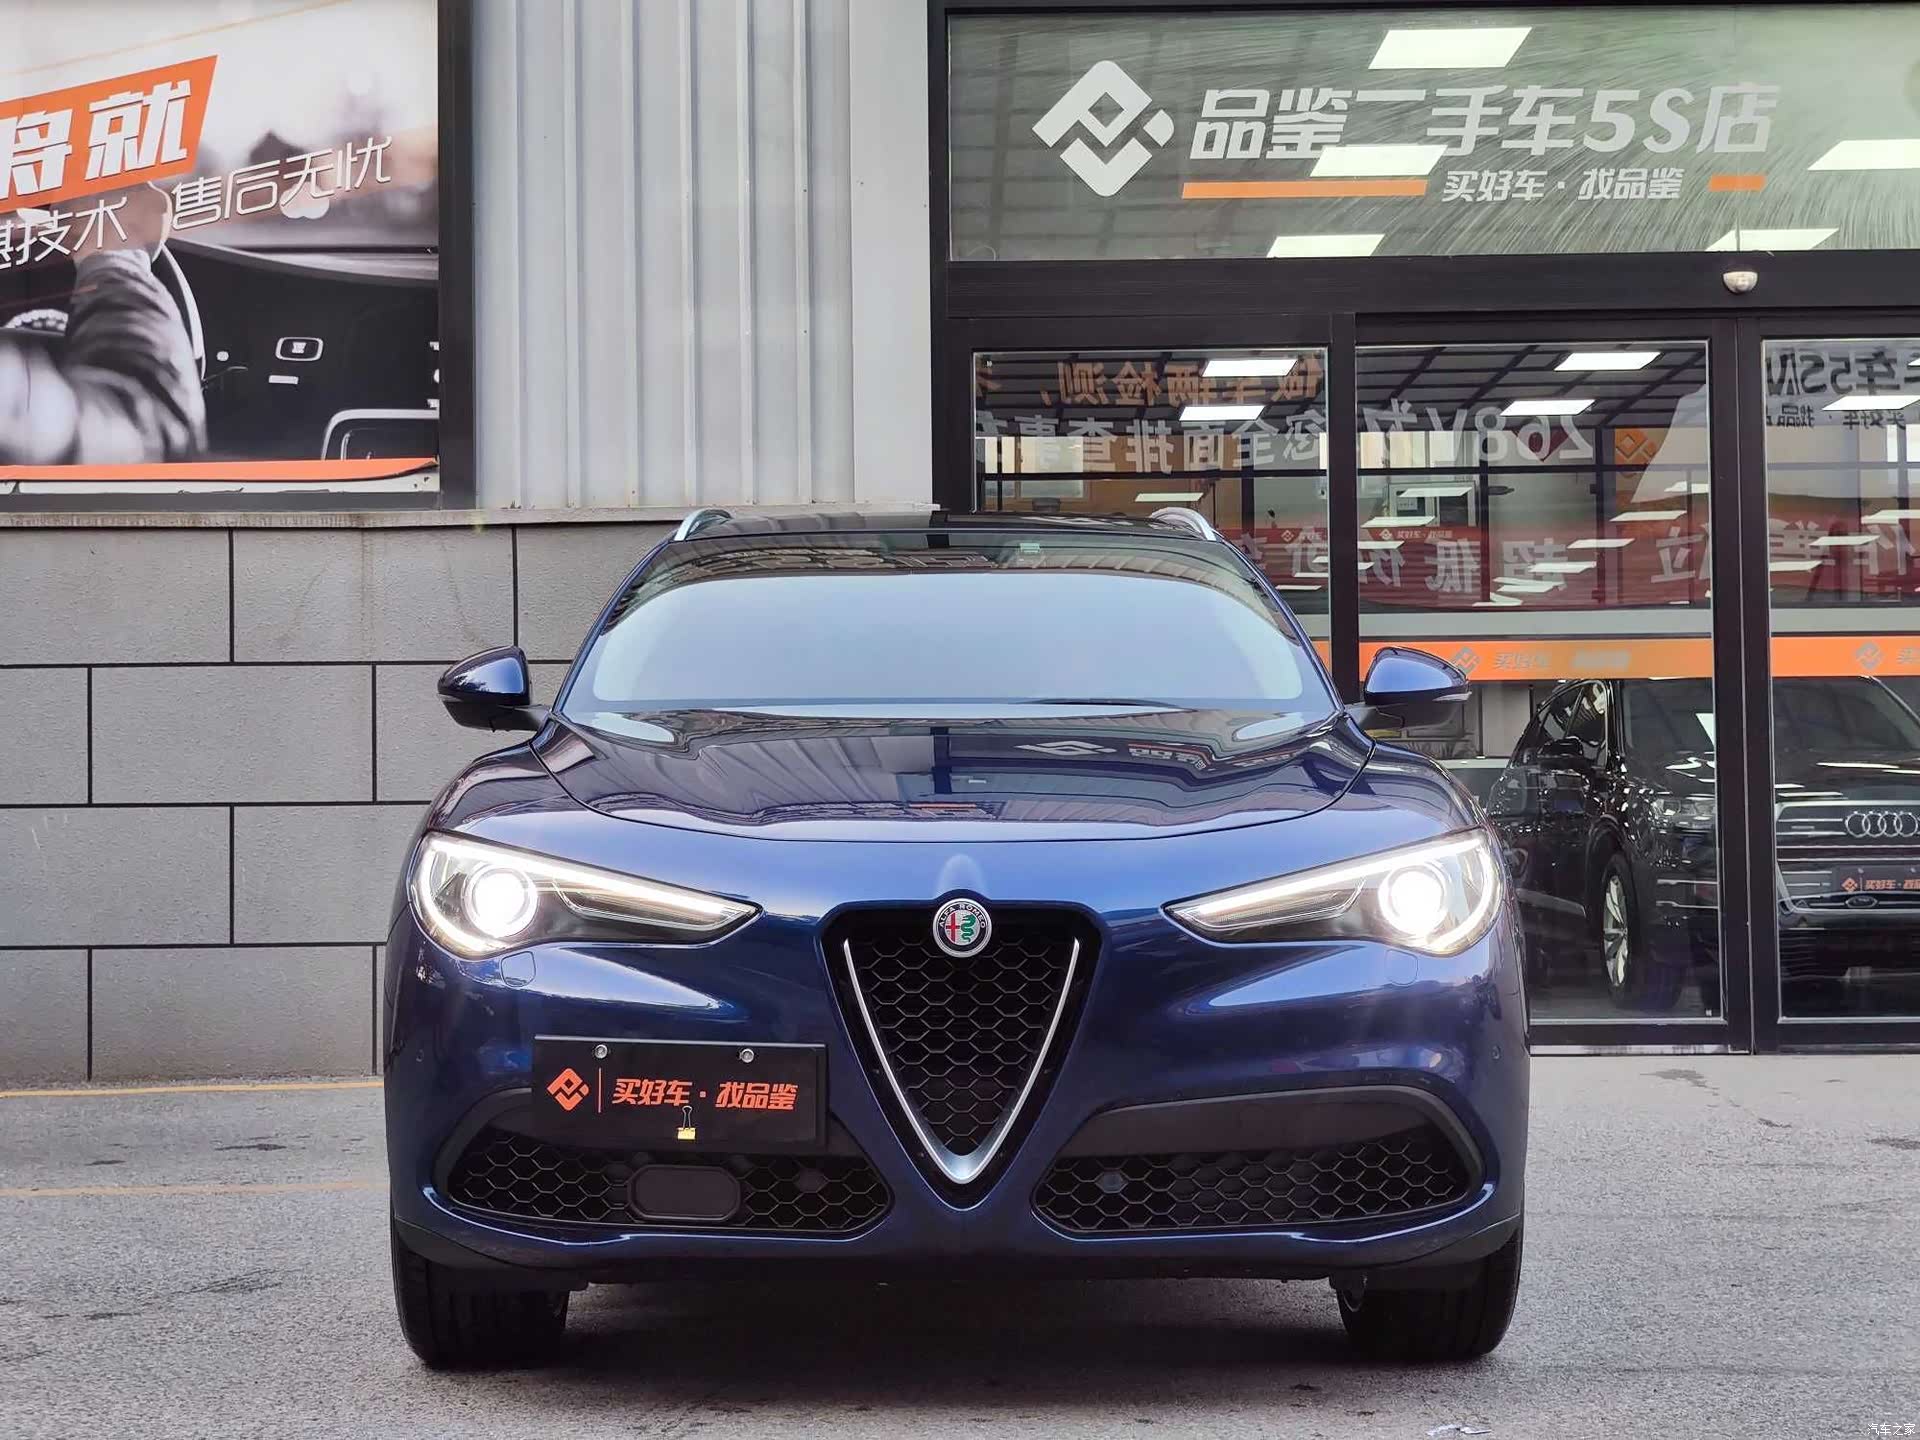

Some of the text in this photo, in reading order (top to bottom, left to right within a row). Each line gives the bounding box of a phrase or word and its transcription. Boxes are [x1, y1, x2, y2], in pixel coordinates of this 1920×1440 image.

[171, 135, 393, 230] 售后无忧
[939, 902, 986, 929] ALFA ROMEO
